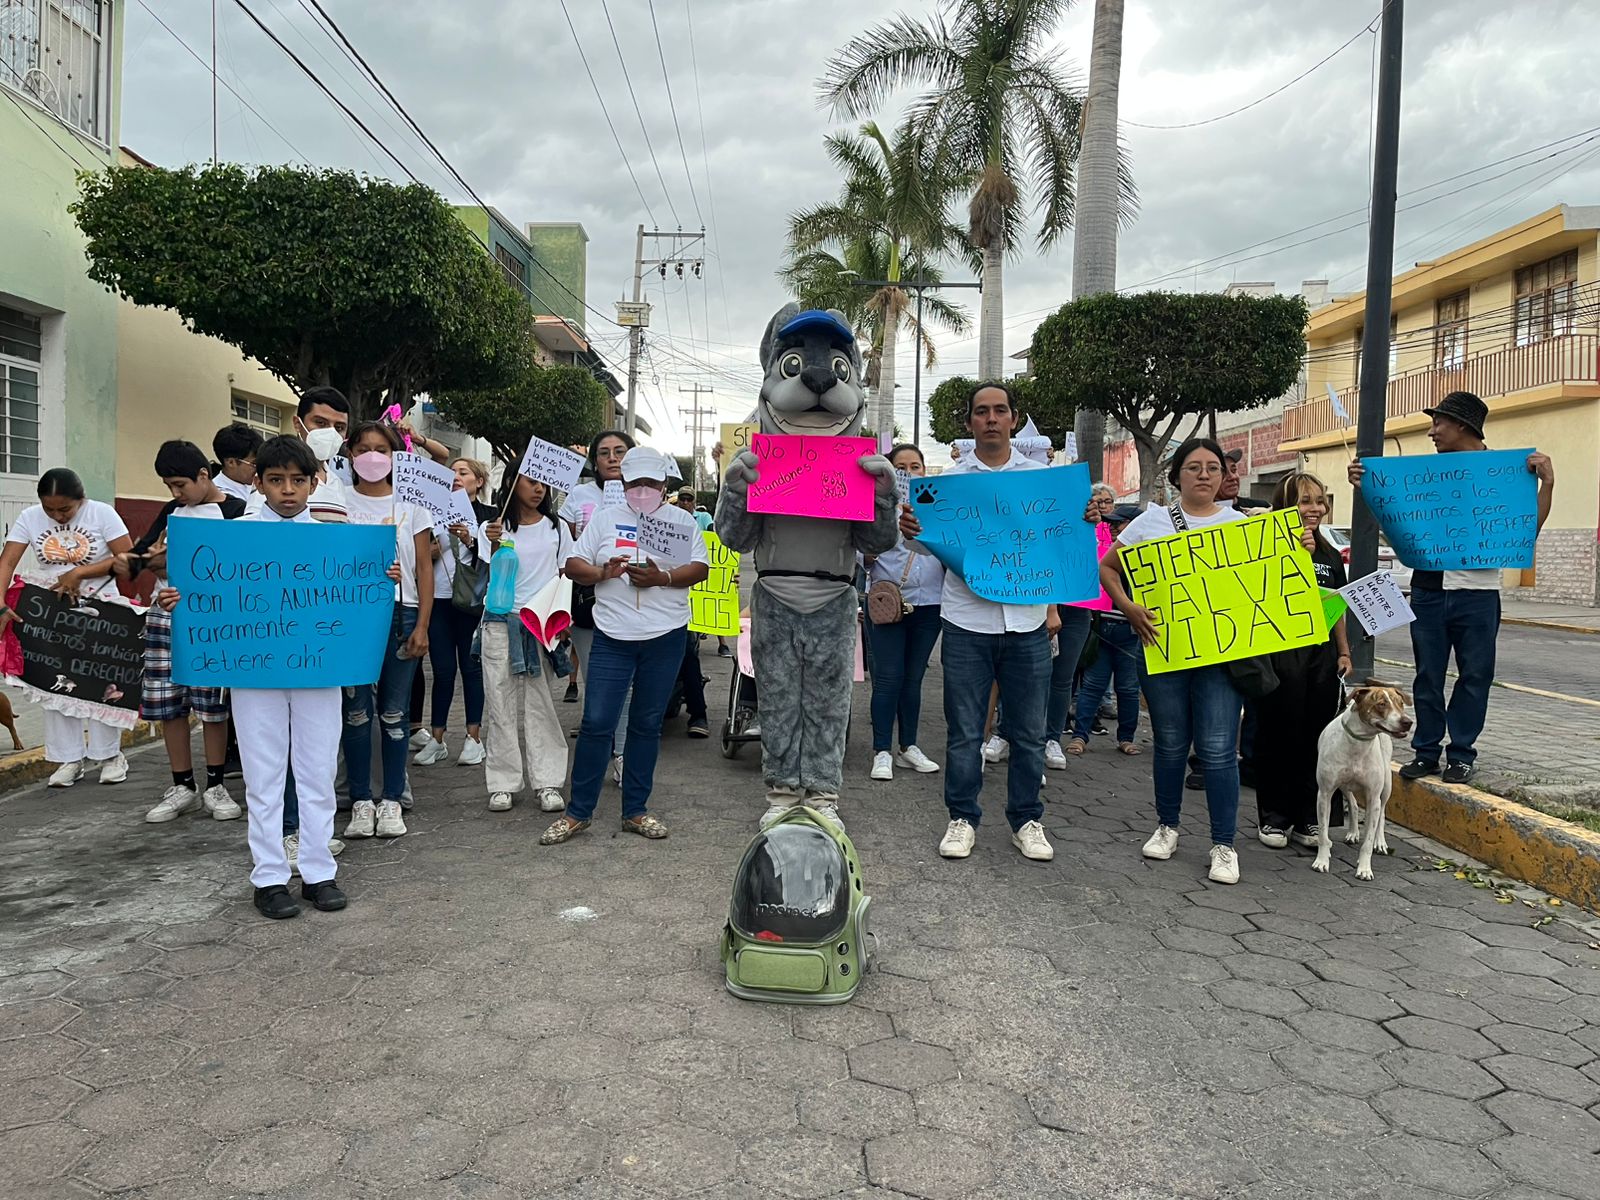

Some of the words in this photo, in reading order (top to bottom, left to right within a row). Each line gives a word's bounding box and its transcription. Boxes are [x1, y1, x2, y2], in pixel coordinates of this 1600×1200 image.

[533, 448, 540, 459] la
[535, 439, 545, 450] Un
[754, 439, 785, 460] No
[800, 437, 818, 463] lo
[397, 452, 422, 465] DIA
[397, 474, 418, 485] DEL
[750, 463, 812, 497] abandones
[1371, 469, 1396, 489] No
[1404, 467, 1474, 491] podemos
[1488, 463, 1526, 484] exigir
[396, 485, 425, 499] ERRO
[1372, 494, 1398, 509] que
[1405, 490, 1442, 502] ames
[1452, 489, 1463, 499] a
[1472, 483, 1499, 498] los
[933, 498, 981, 532] Soy
[995, 493, 1011, 516] la
[1021, 497, 1061, 516] voz
[1473, 503, 1510, 521] pero
[976, 528, 1005, 547] ser
[1010, 527, 1036, 550] que
[1044, 518, 1073, 541] más
[1403, 530, 1434, 547] que
[1446, 523, 1470, 538] los
[1122, 509, 1304, 589] ESTERILIZAR
[191, 545, 283, 583] Quien
[293, 561, 315, 581] es
[1142, 554, 1312, 627] SALVA
[1373, 574, 1385, 585] NO
[188, 592, 222, 613] con
[239, 587, 270, 614] los
[28, 595, 51, 620] Si
[54, 611, 129, 638] pagamos
[188, 615, 299, 645] raramente
[316, 619, 346, 638] se
[1151, 590, 1314, 663] VIDAS
[23, 623, 86, 651] IMPUESTOS
[91, 642, 140, 663] también
[23, 650, 62, 670] enemos
[191, 648, 275, 674] detiene
[287, 644, 327, 670] ahí
